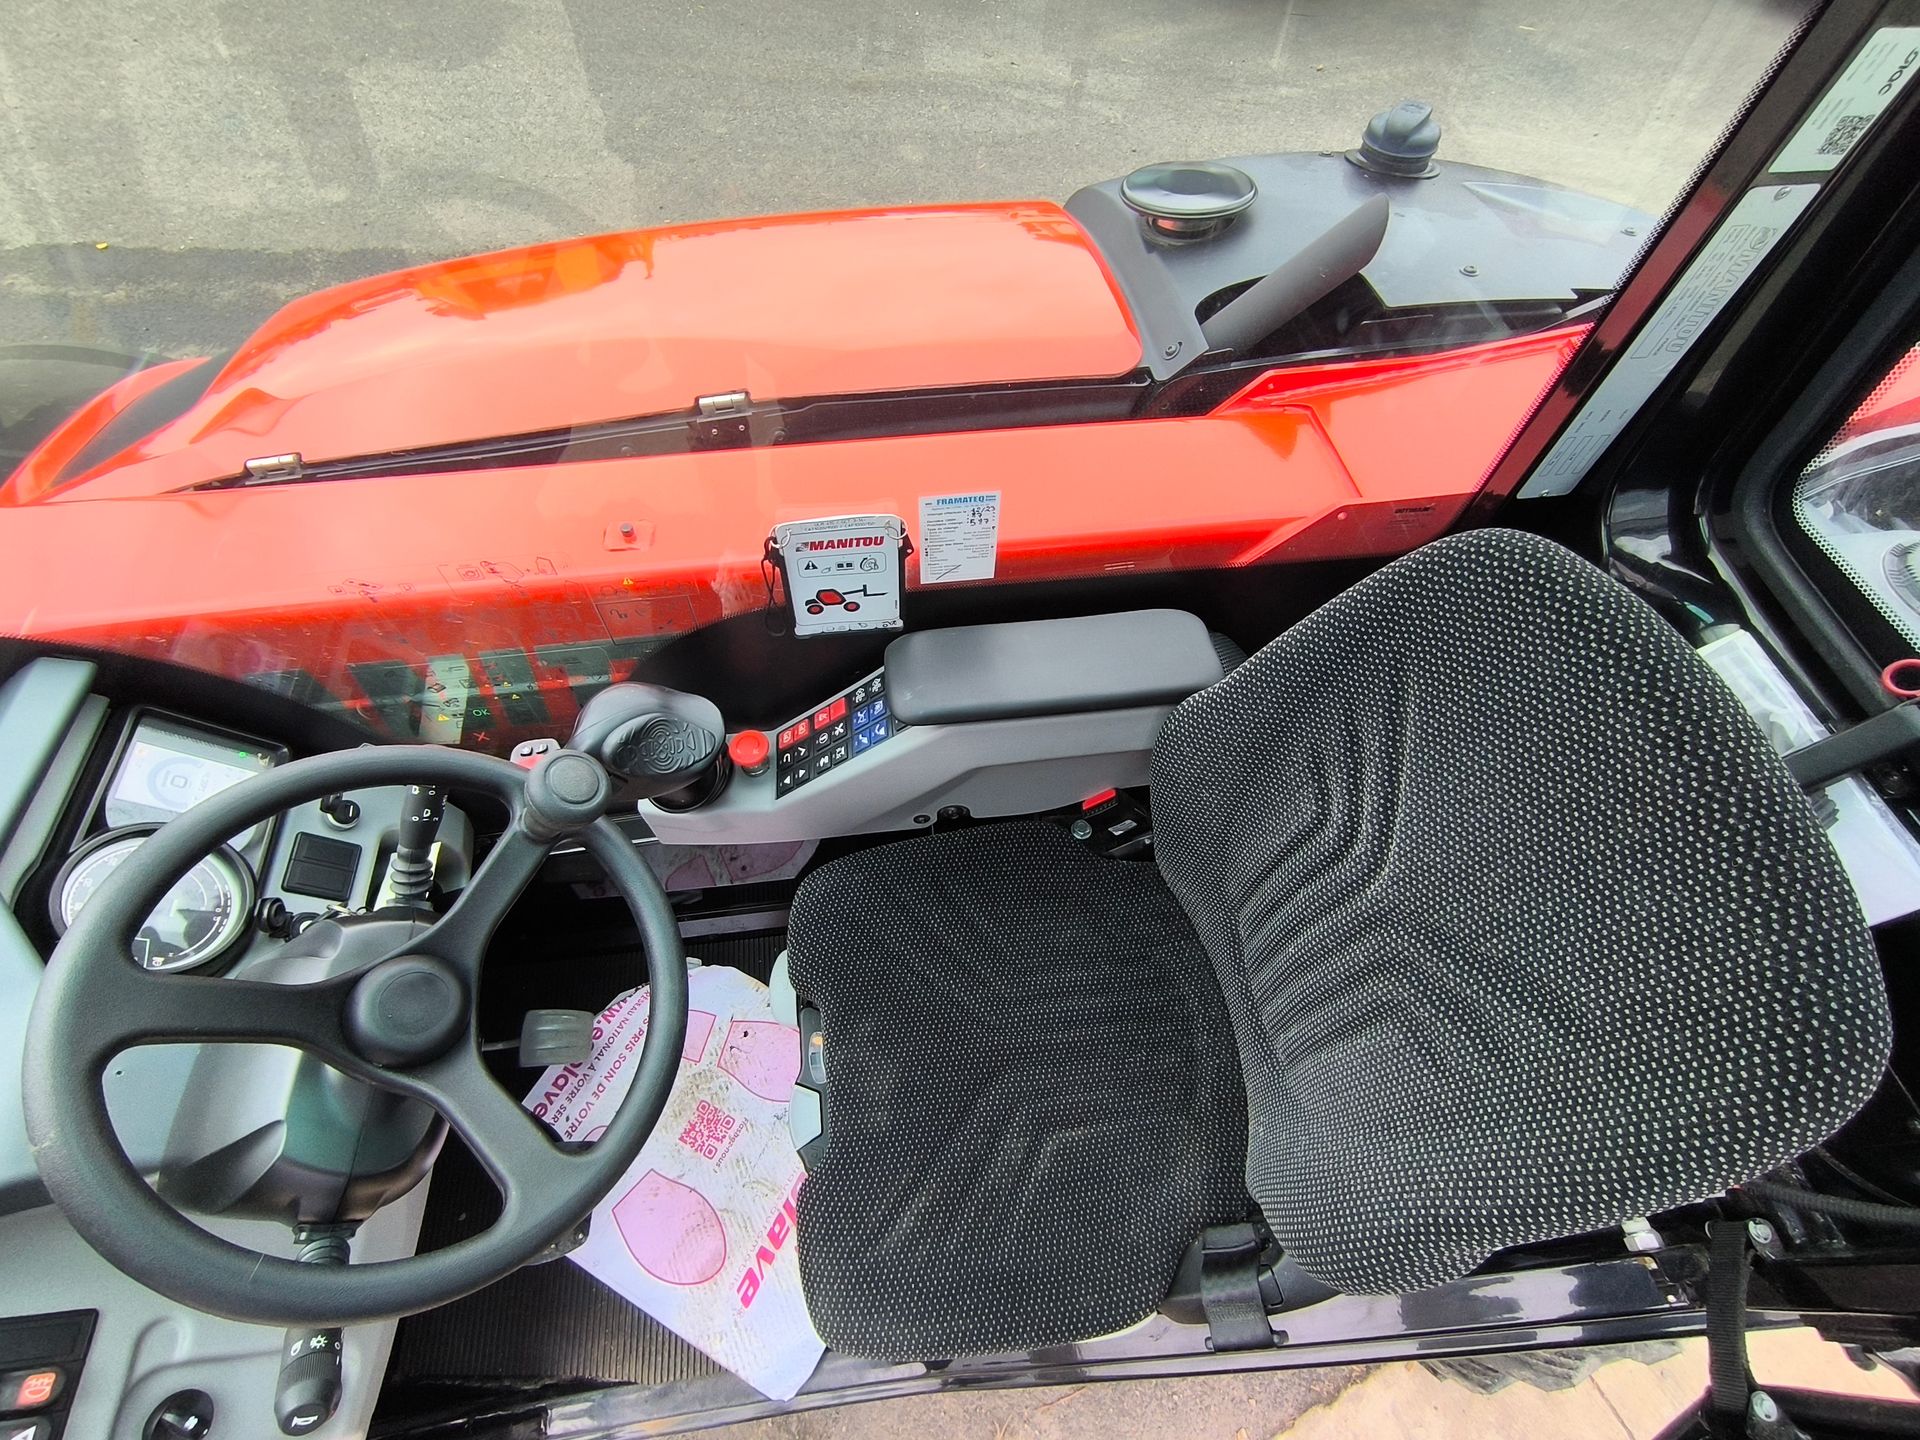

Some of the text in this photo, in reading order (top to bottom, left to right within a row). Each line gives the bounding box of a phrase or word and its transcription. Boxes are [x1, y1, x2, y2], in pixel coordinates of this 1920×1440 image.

[1665, 246, 1761, 353] MANITOU
[936, 495, 985, 506] FRAMATEQ
[809, 535, 885, 552] MANITOU
[472, 709, 491, 718] OK
[594, 1016, 629, 1061] NATIONAL
[624, 1027, 645, 1053] PRIS
[604, 1052, 628, 1084] SOIN
[565, 1072, 590, 1104] VOTRE
[591, 1084, 607, 1101] DE
[564, 1101, 595, 1140] VOTRE
